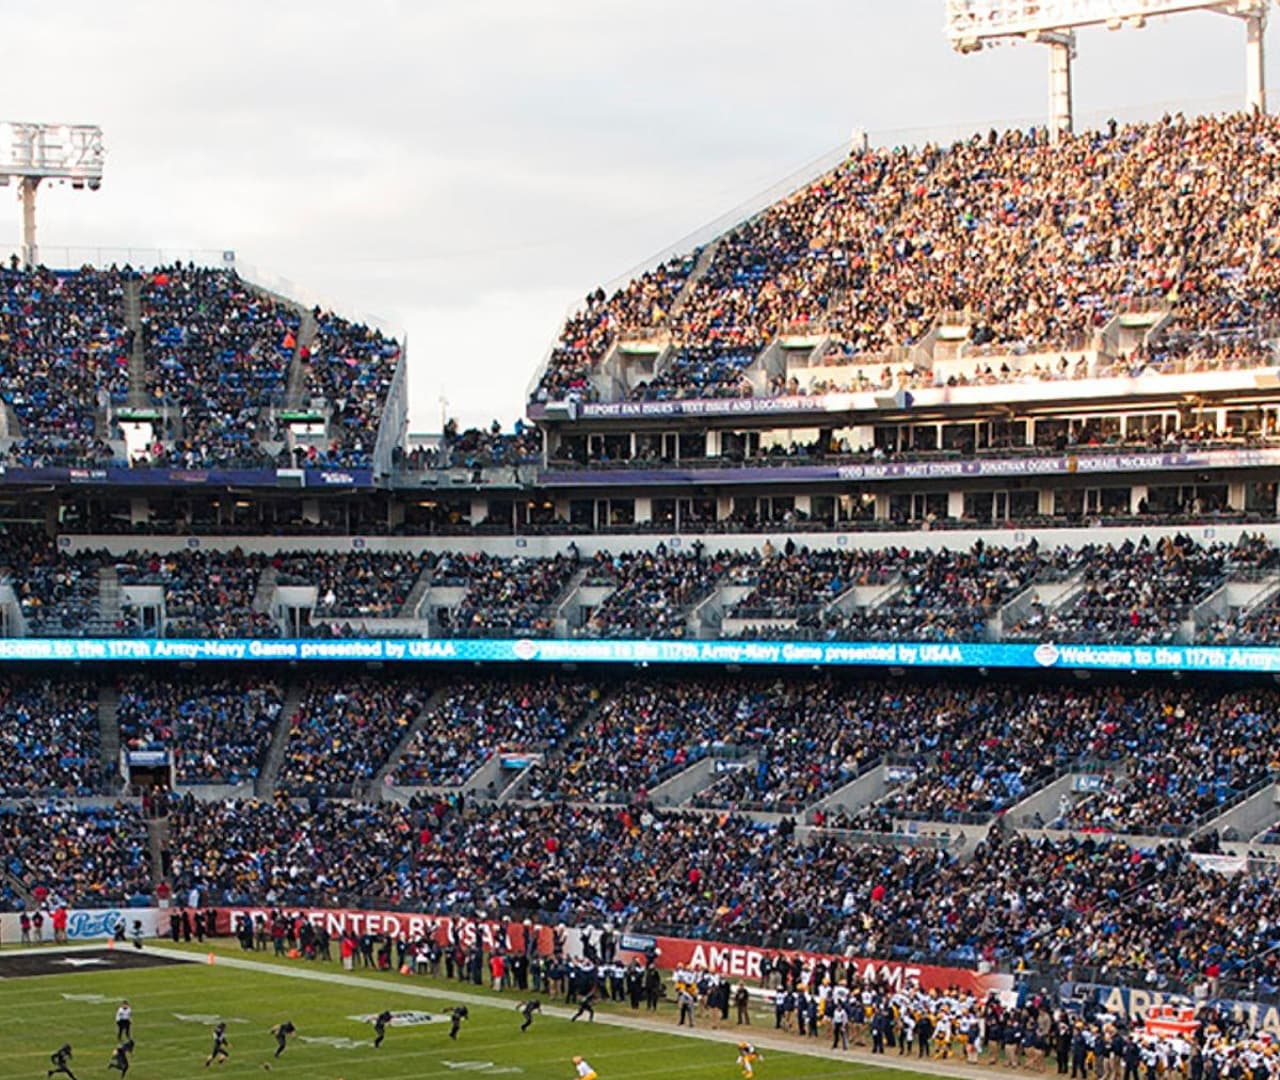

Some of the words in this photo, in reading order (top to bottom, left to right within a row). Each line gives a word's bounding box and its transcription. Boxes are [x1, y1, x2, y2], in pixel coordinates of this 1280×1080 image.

[57, 640, 74, 656] to
[77, 640, 105, 657] the
[153, 640, 245, 659] Army-Navy
[249, 641, 297, 657] Game
[301, 641, 382, 659] presented
[385, 641, 405, 659] by
[409, 641, 456, 657] USAA
[701, 643, 780, 662] Army-Navy
[782, 644, 822, 661] Game
[825, 645, 896, 663] presented
[899, 645, 916, 663] by
[919, 645, 963, 662] USAA
[1060, 647, 1132, 664] Welcome
[1134, 648, 1152, 664] to
[1155, 648, 1182, 665] the
[1186, 648, 1226, 666] 117th
